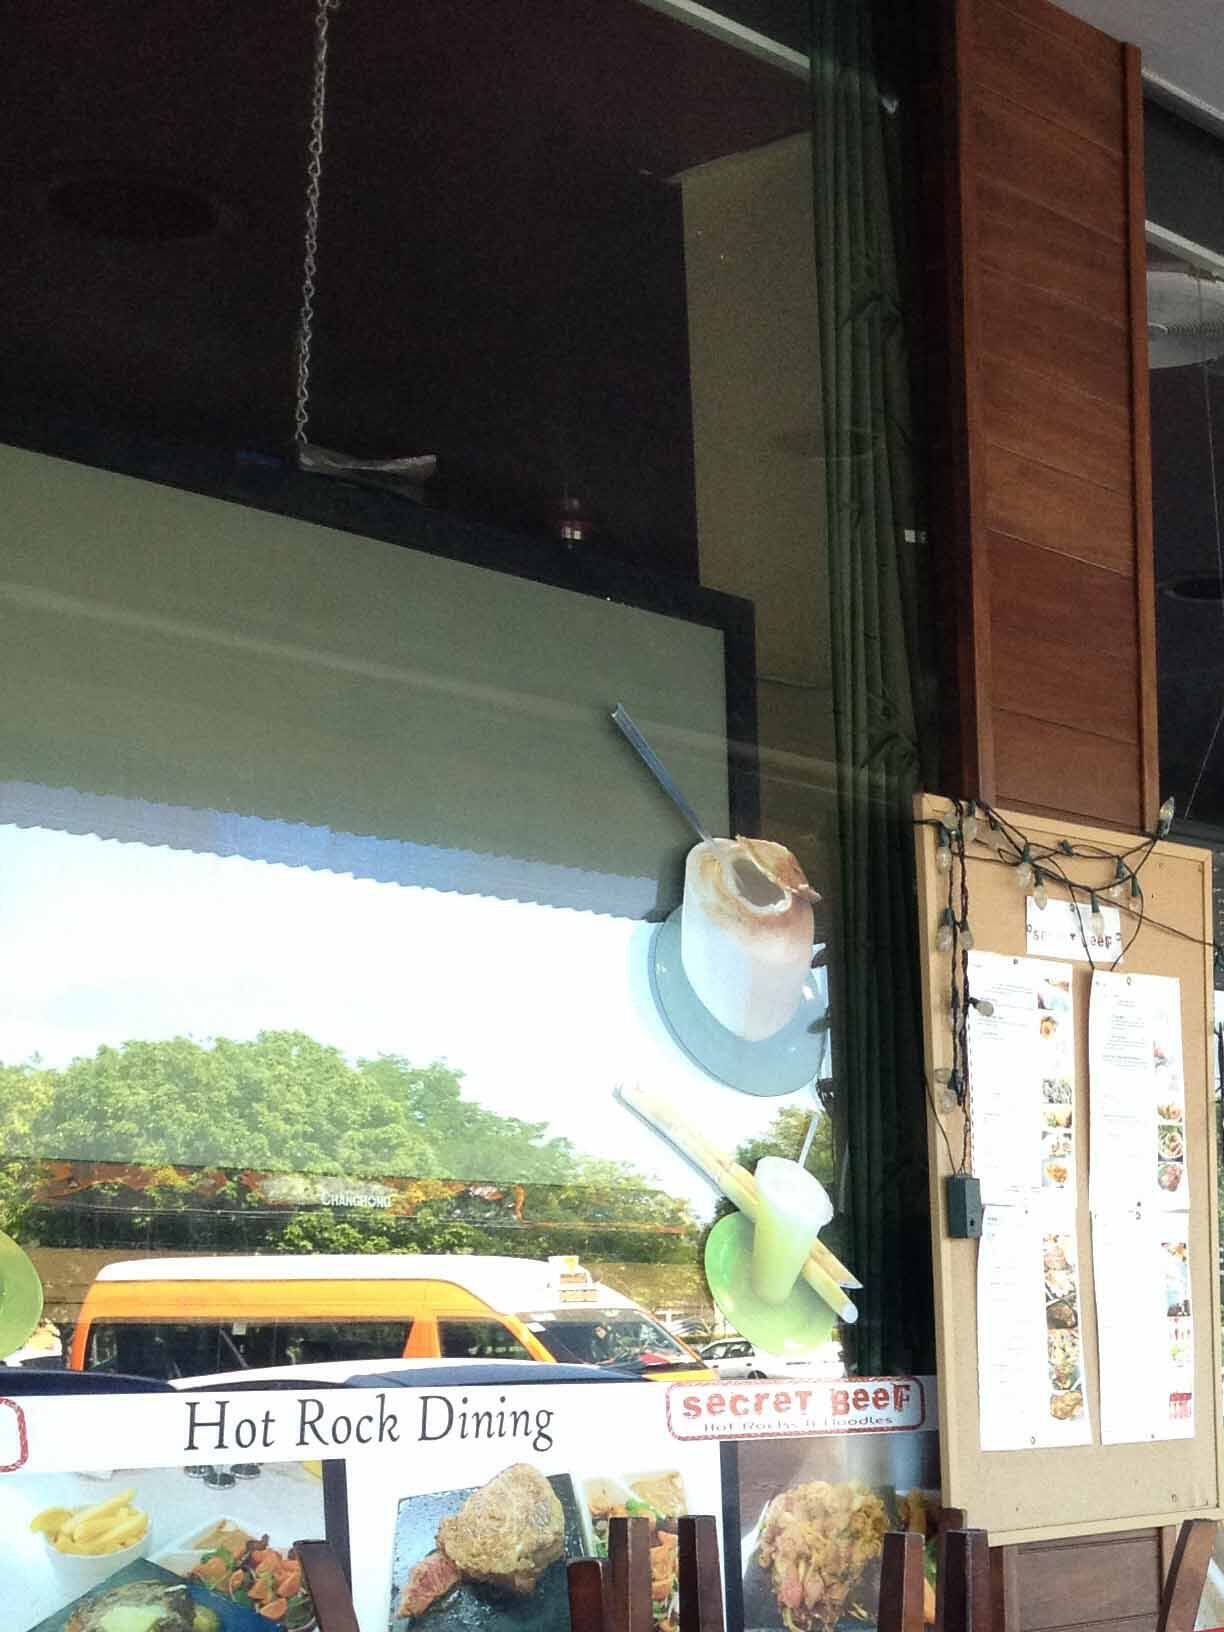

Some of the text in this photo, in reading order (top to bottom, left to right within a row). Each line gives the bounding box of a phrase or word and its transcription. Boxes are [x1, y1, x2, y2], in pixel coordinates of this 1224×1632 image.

[184, 1393, 553, 1452] Hot Rock Dining
